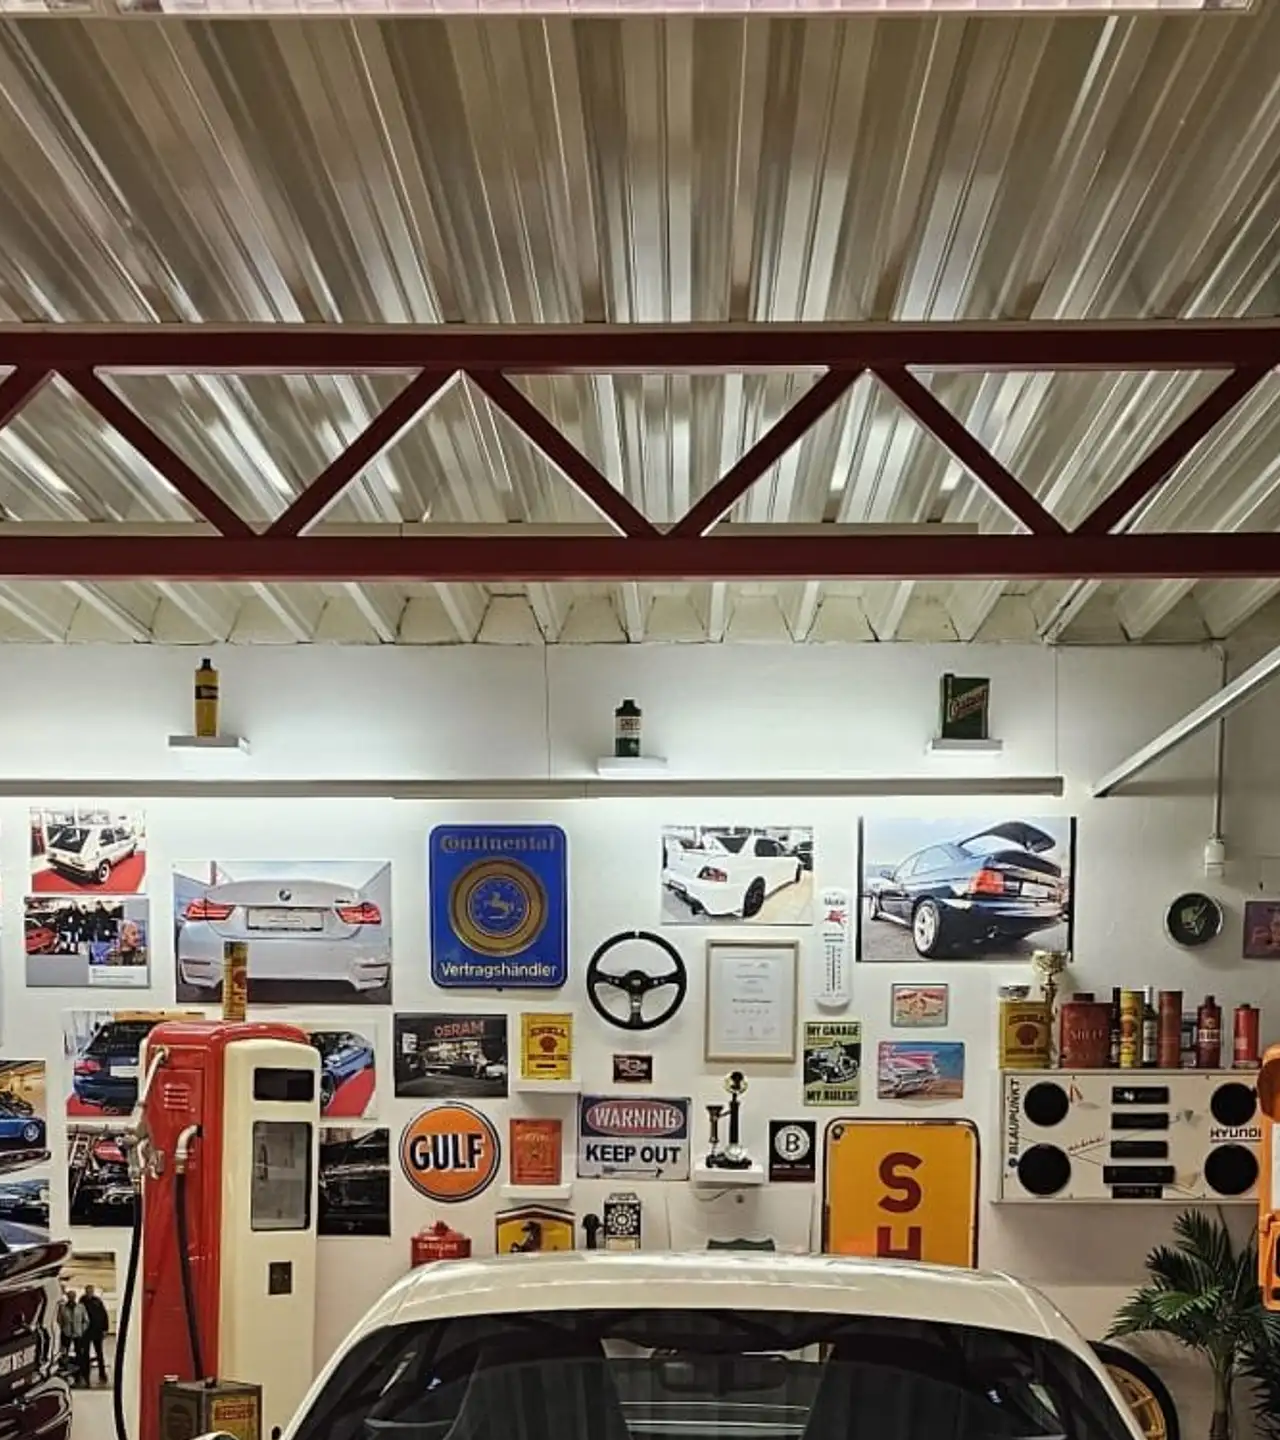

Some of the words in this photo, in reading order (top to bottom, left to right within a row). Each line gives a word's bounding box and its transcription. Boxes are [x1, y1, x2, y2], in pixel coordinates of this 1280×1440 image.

[441, 834, 555, 853] Continental
[441, 962, 557, 979] Vertragshändler
[434, 1019, 486, 1038] OSRAM
[594, 1106, 678, 1129] WARNING
[1009, 1078, 1020, 1155] BLAUPUNKT
[786, 1132, 800, 1152] B
[410, 1133, 486, 1173] GULF
[586, 1144, 637, 1163] KEEP
[640, 1146, 681, 1164] OUT
